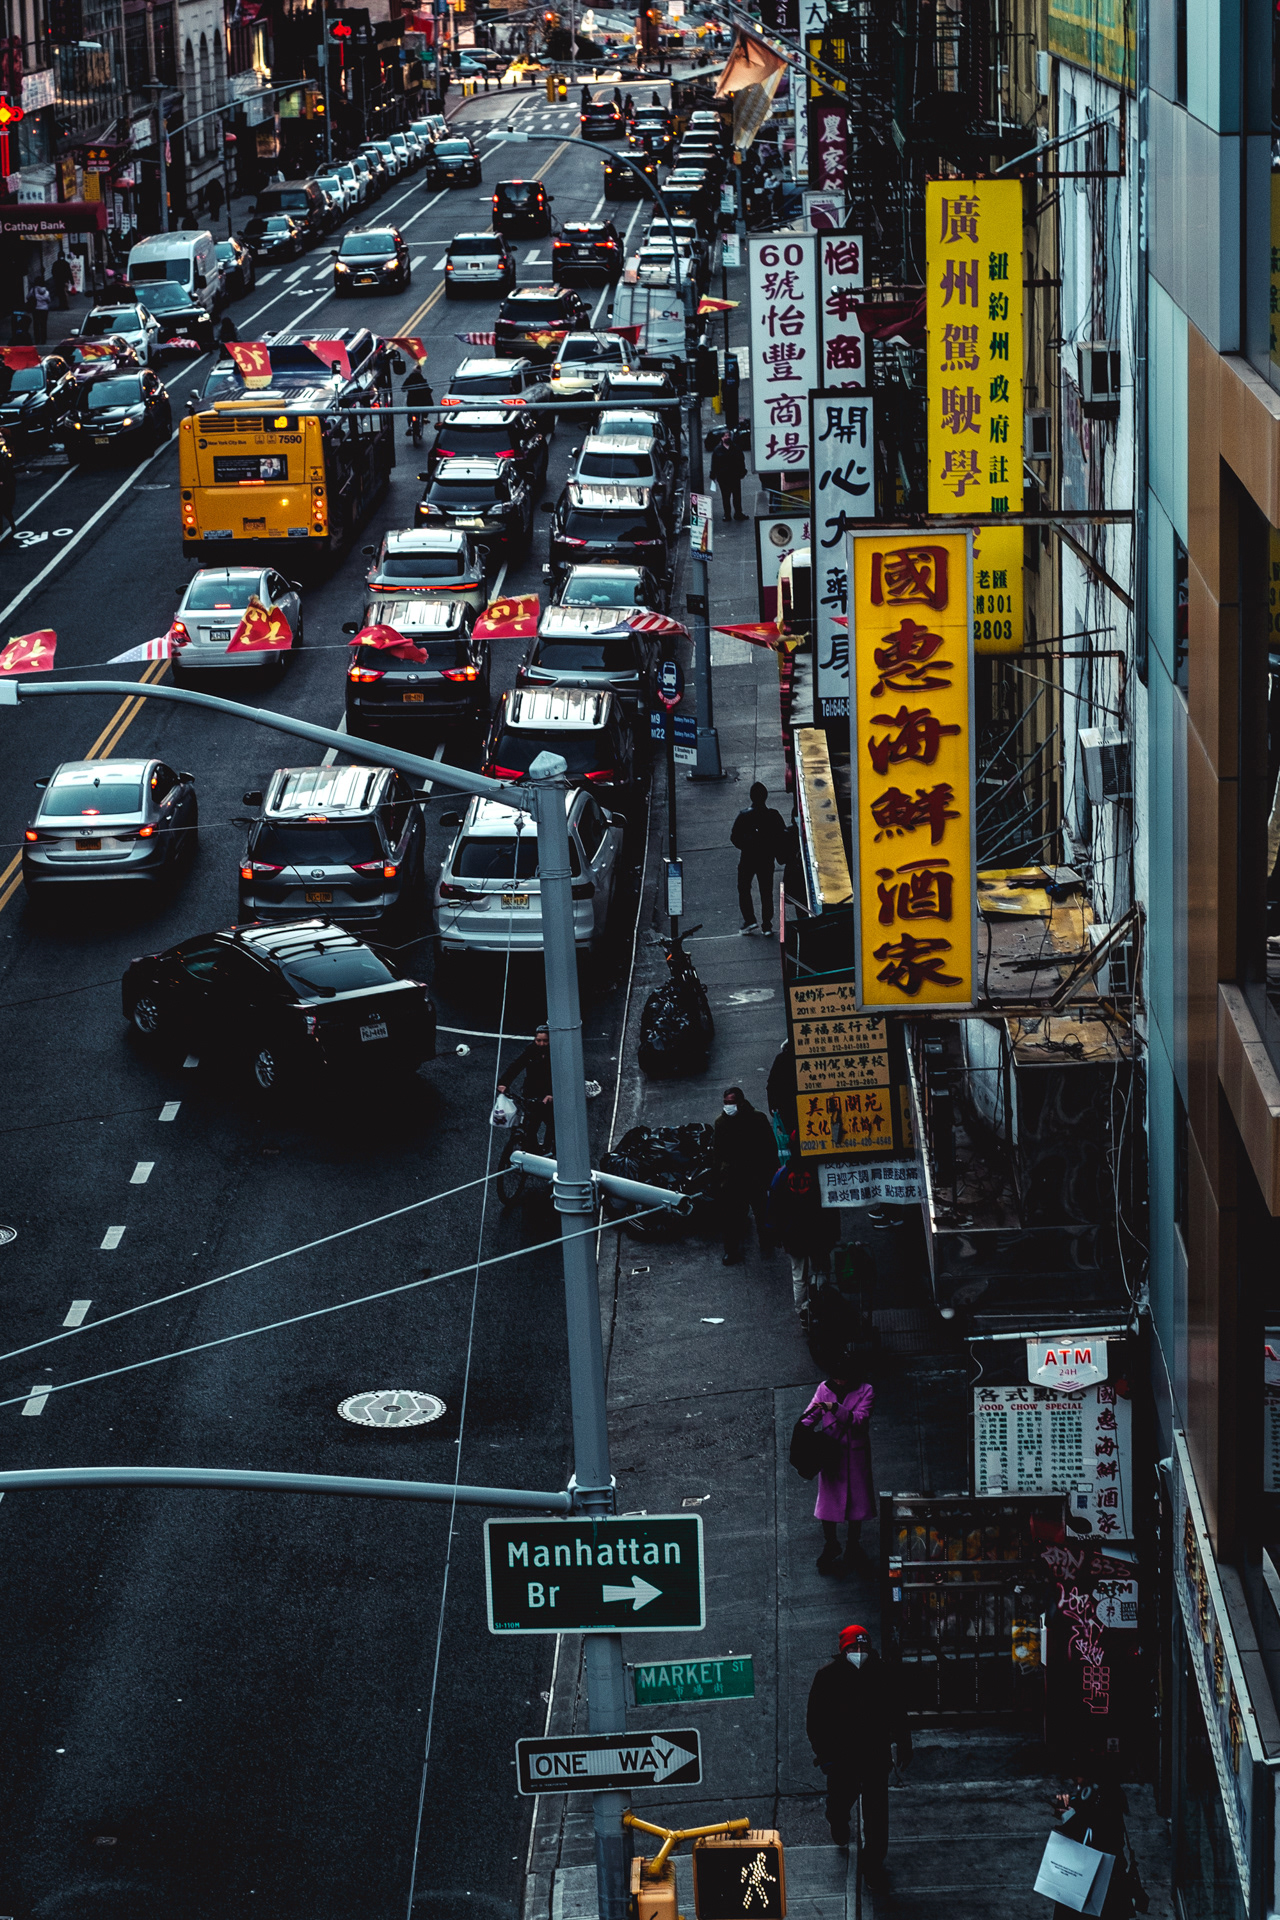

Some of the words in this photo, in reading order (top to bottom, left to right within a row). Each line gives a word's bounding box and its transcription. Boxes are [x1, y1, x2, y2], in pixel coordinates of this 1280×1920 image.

[805, 2, 826, 32] 大
[4, 221, 39, 232] Cathay
[40, 219, 66, 231] Bank
[939, 194, 981, 559] 廣州駕駛學
[278, 434, 302, 444] 7590
[973, 594, 1012, 615] 樓301
[650, 713, 661, 725] M9
[650, 728, 666, 740] M22
[868, 544, 963, 995] 國惠海鮮酒家
[820, 1004, 856, 1014] 212-941
[800, 1055, 886, 1073] 廣州駕駛學校
[836, 1078, 878, 1088] 212-219-2803
[884, 1184, 921, 1199] 點痣疣
[1044, 1348, 1092, 1366] ATM
[1059, 1368, 1078, 1376] 24H
[1010, 1403, 1038, 1411] CHOW
[1045, 1402, 1083, 1410] SPECIAL
[1095, 1386, 1120, 1534] 國惠海鮮酒家
[507, 1538, 681, 1568] Manhattan
[527, 1582, 560, 1608] Br
[639, 1662, 724, 1689] MARKET
[732, 1660, 745, 1672] ST
[535, 1753, 588, 1776] ONE
[618, 1747, 674, 1772] WAY
